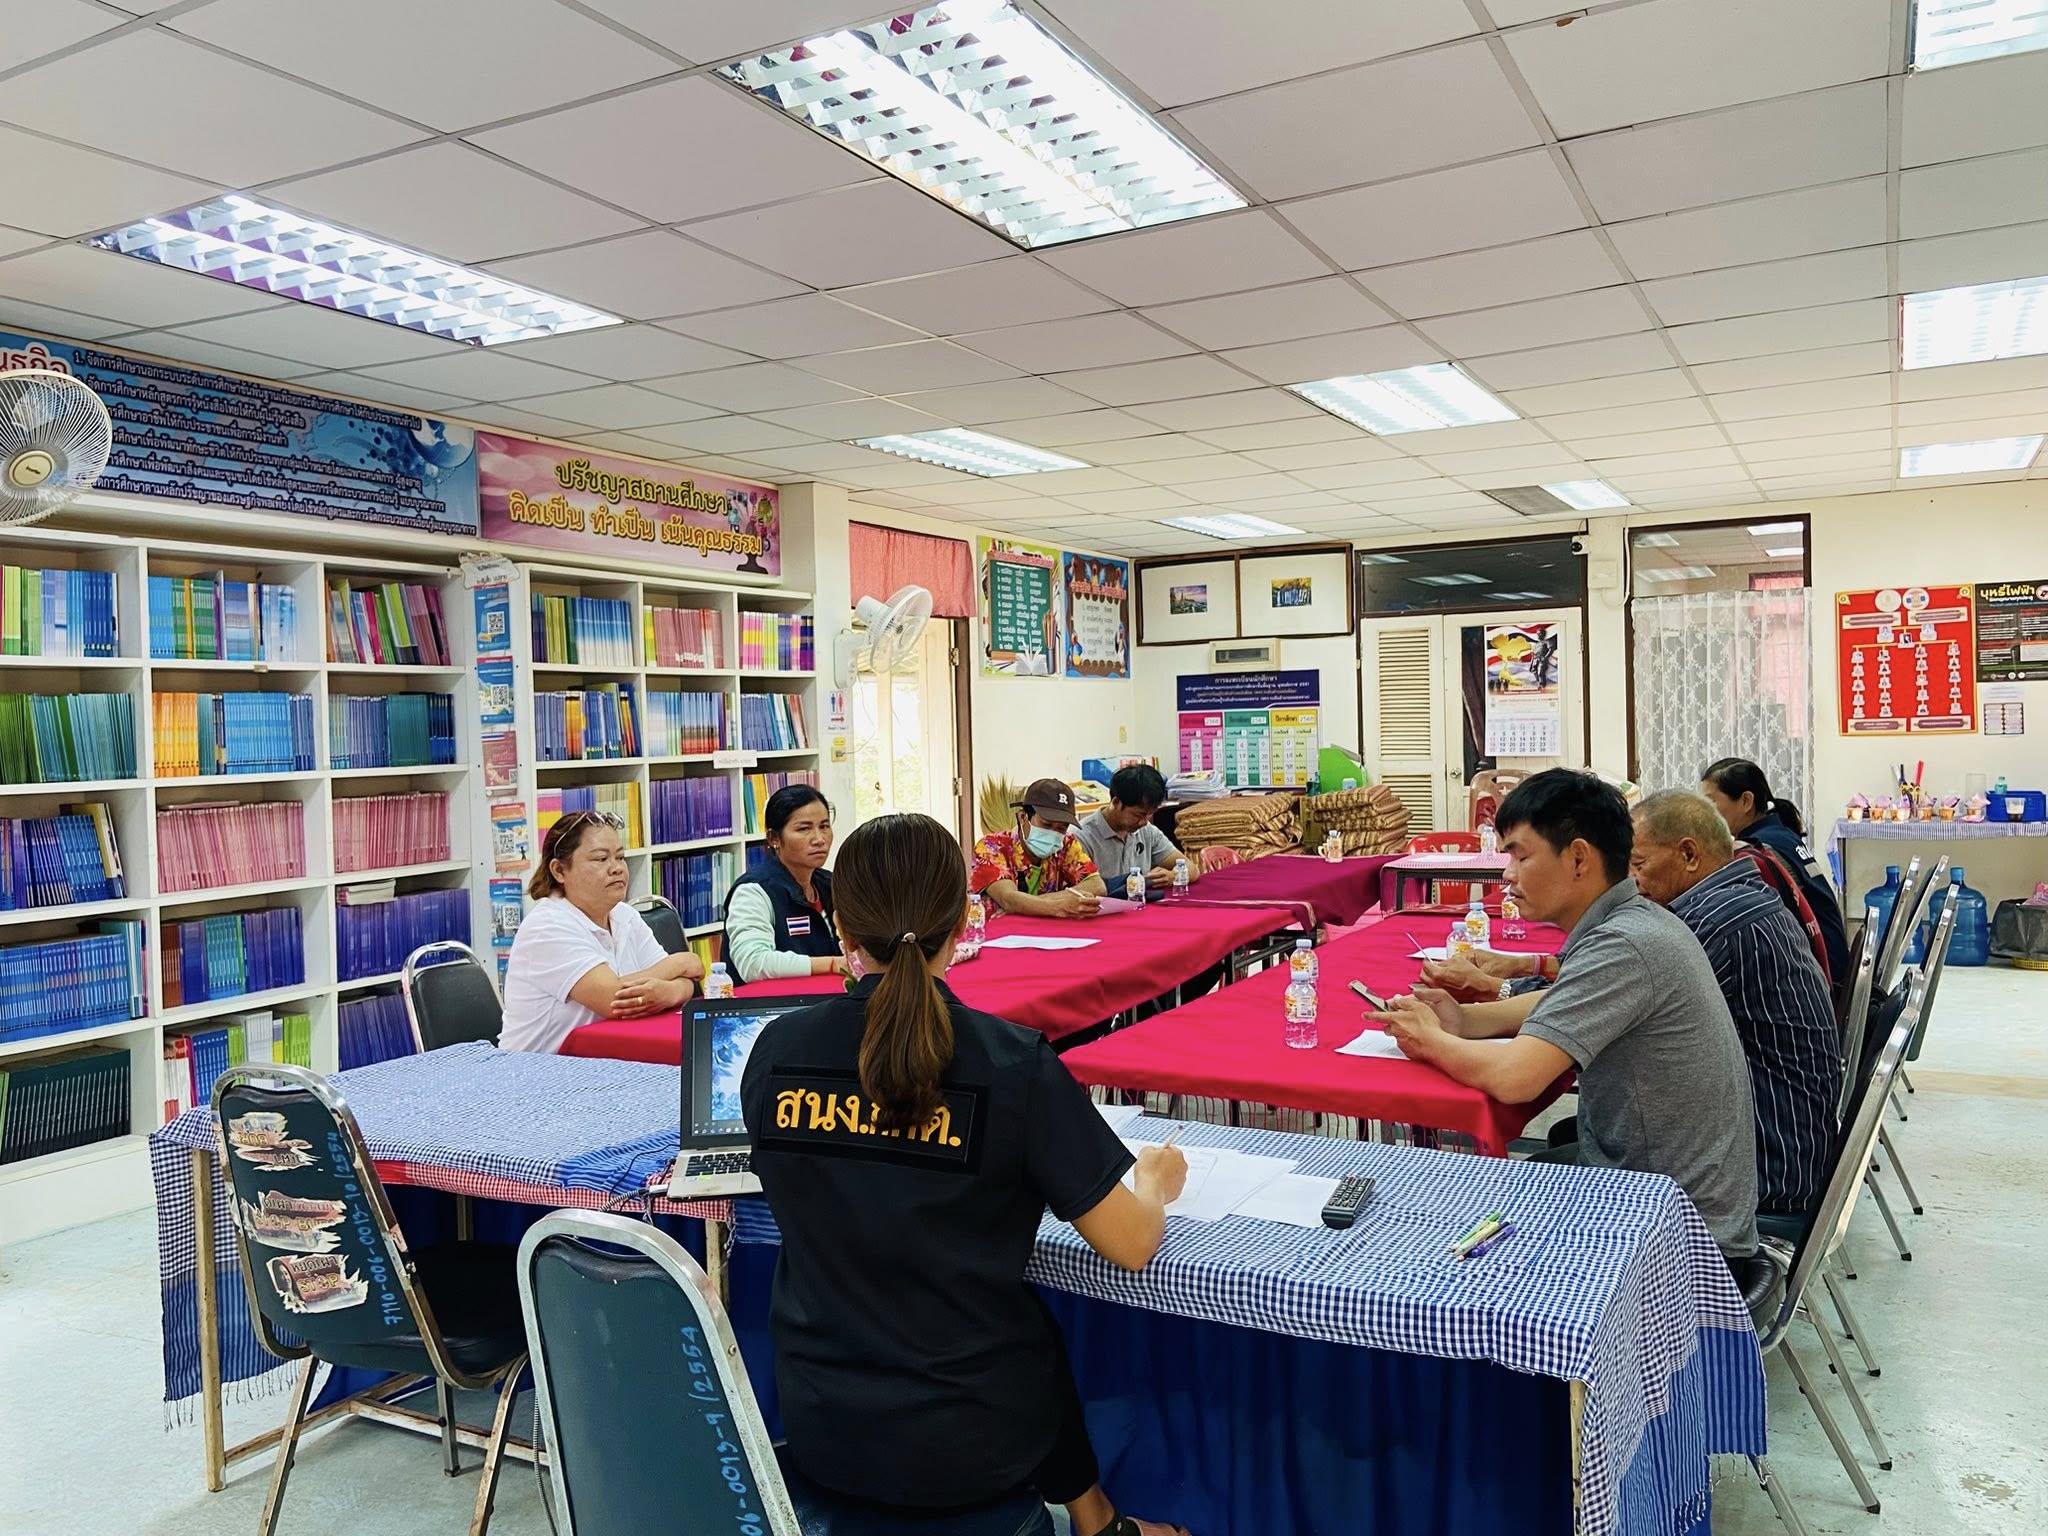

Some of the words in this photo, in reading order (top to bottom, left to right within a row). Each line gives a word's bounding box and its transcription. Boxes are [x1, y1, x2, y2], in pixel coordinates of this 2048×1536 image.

[555, 459, 730, 517] ปรัชญาสถานศึกษา
[509, 488, 584, 532] คิดเป็น
[590, 505, 656, 543] ทำเป็น
[661, 514, 764, 557] เน้นคุณธรรม
[298, 1273, 339, 1293] STOP
